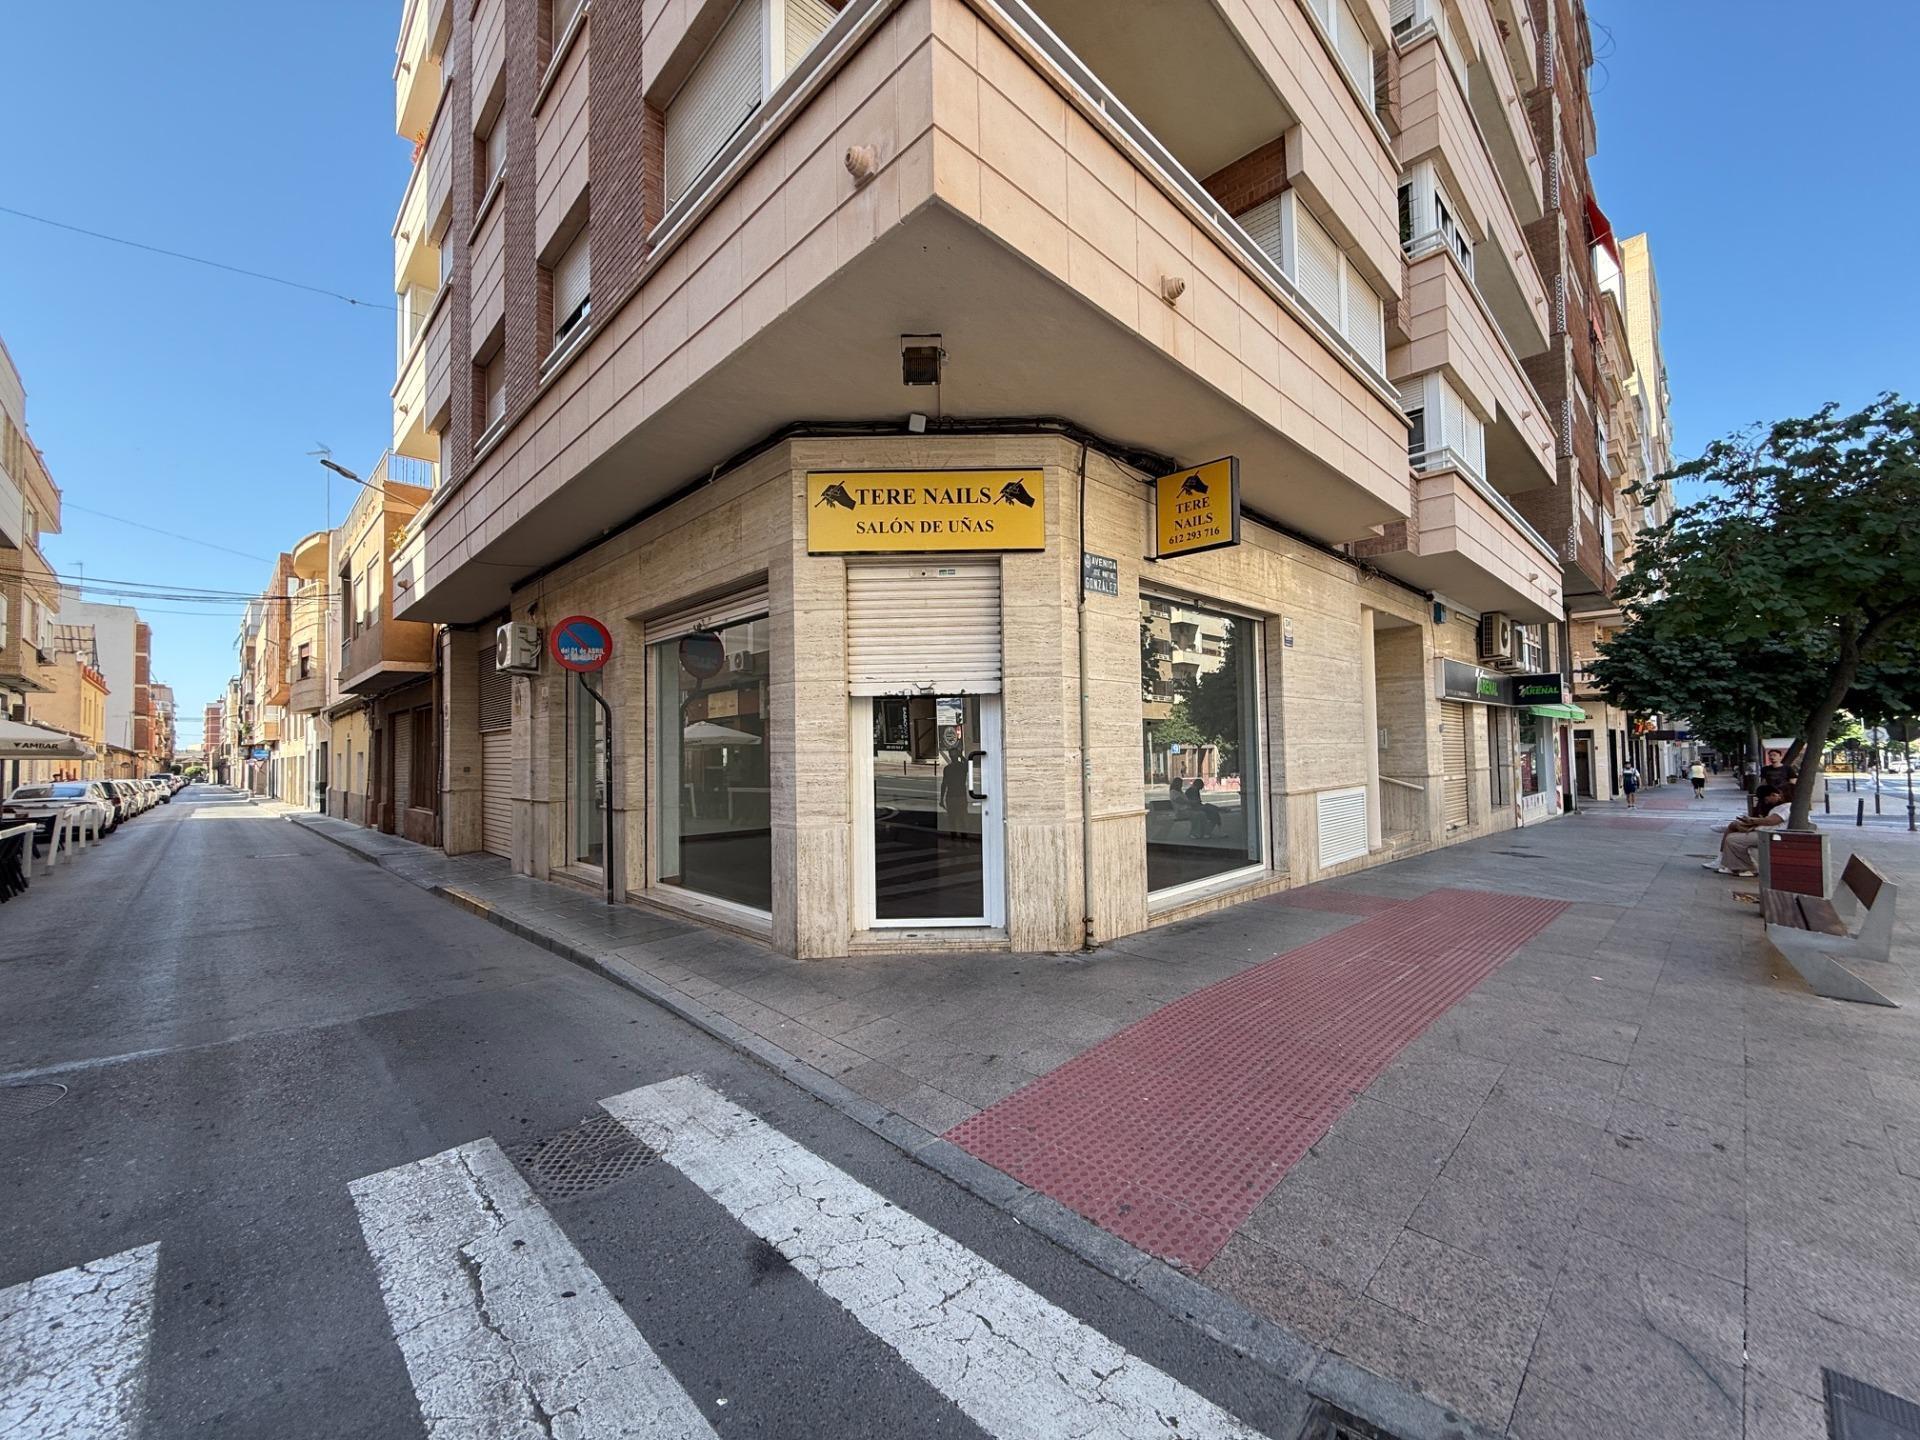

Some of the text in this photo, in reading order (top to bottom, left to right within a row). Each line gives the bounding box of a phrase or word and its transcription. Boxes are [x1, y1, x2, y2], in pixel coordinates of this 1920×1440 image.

[855, 487, 992, 505] TERE NAILS
[1175, 497, 1210, 513] TERE
[856, 516, 994, 534] SALÓN DE UÑAS
[1174, 512, 1213, 531] NAILS
[1168, 526, 1220, 544] 612 293 716
[1091, 556, 1117, 570] AVENIDA
[1085, 576, 1117, 593] GONZÁLEZ
[1525, 686, 1560, 697] ARENAL
[22, 742, 59, 750] AMBAR
